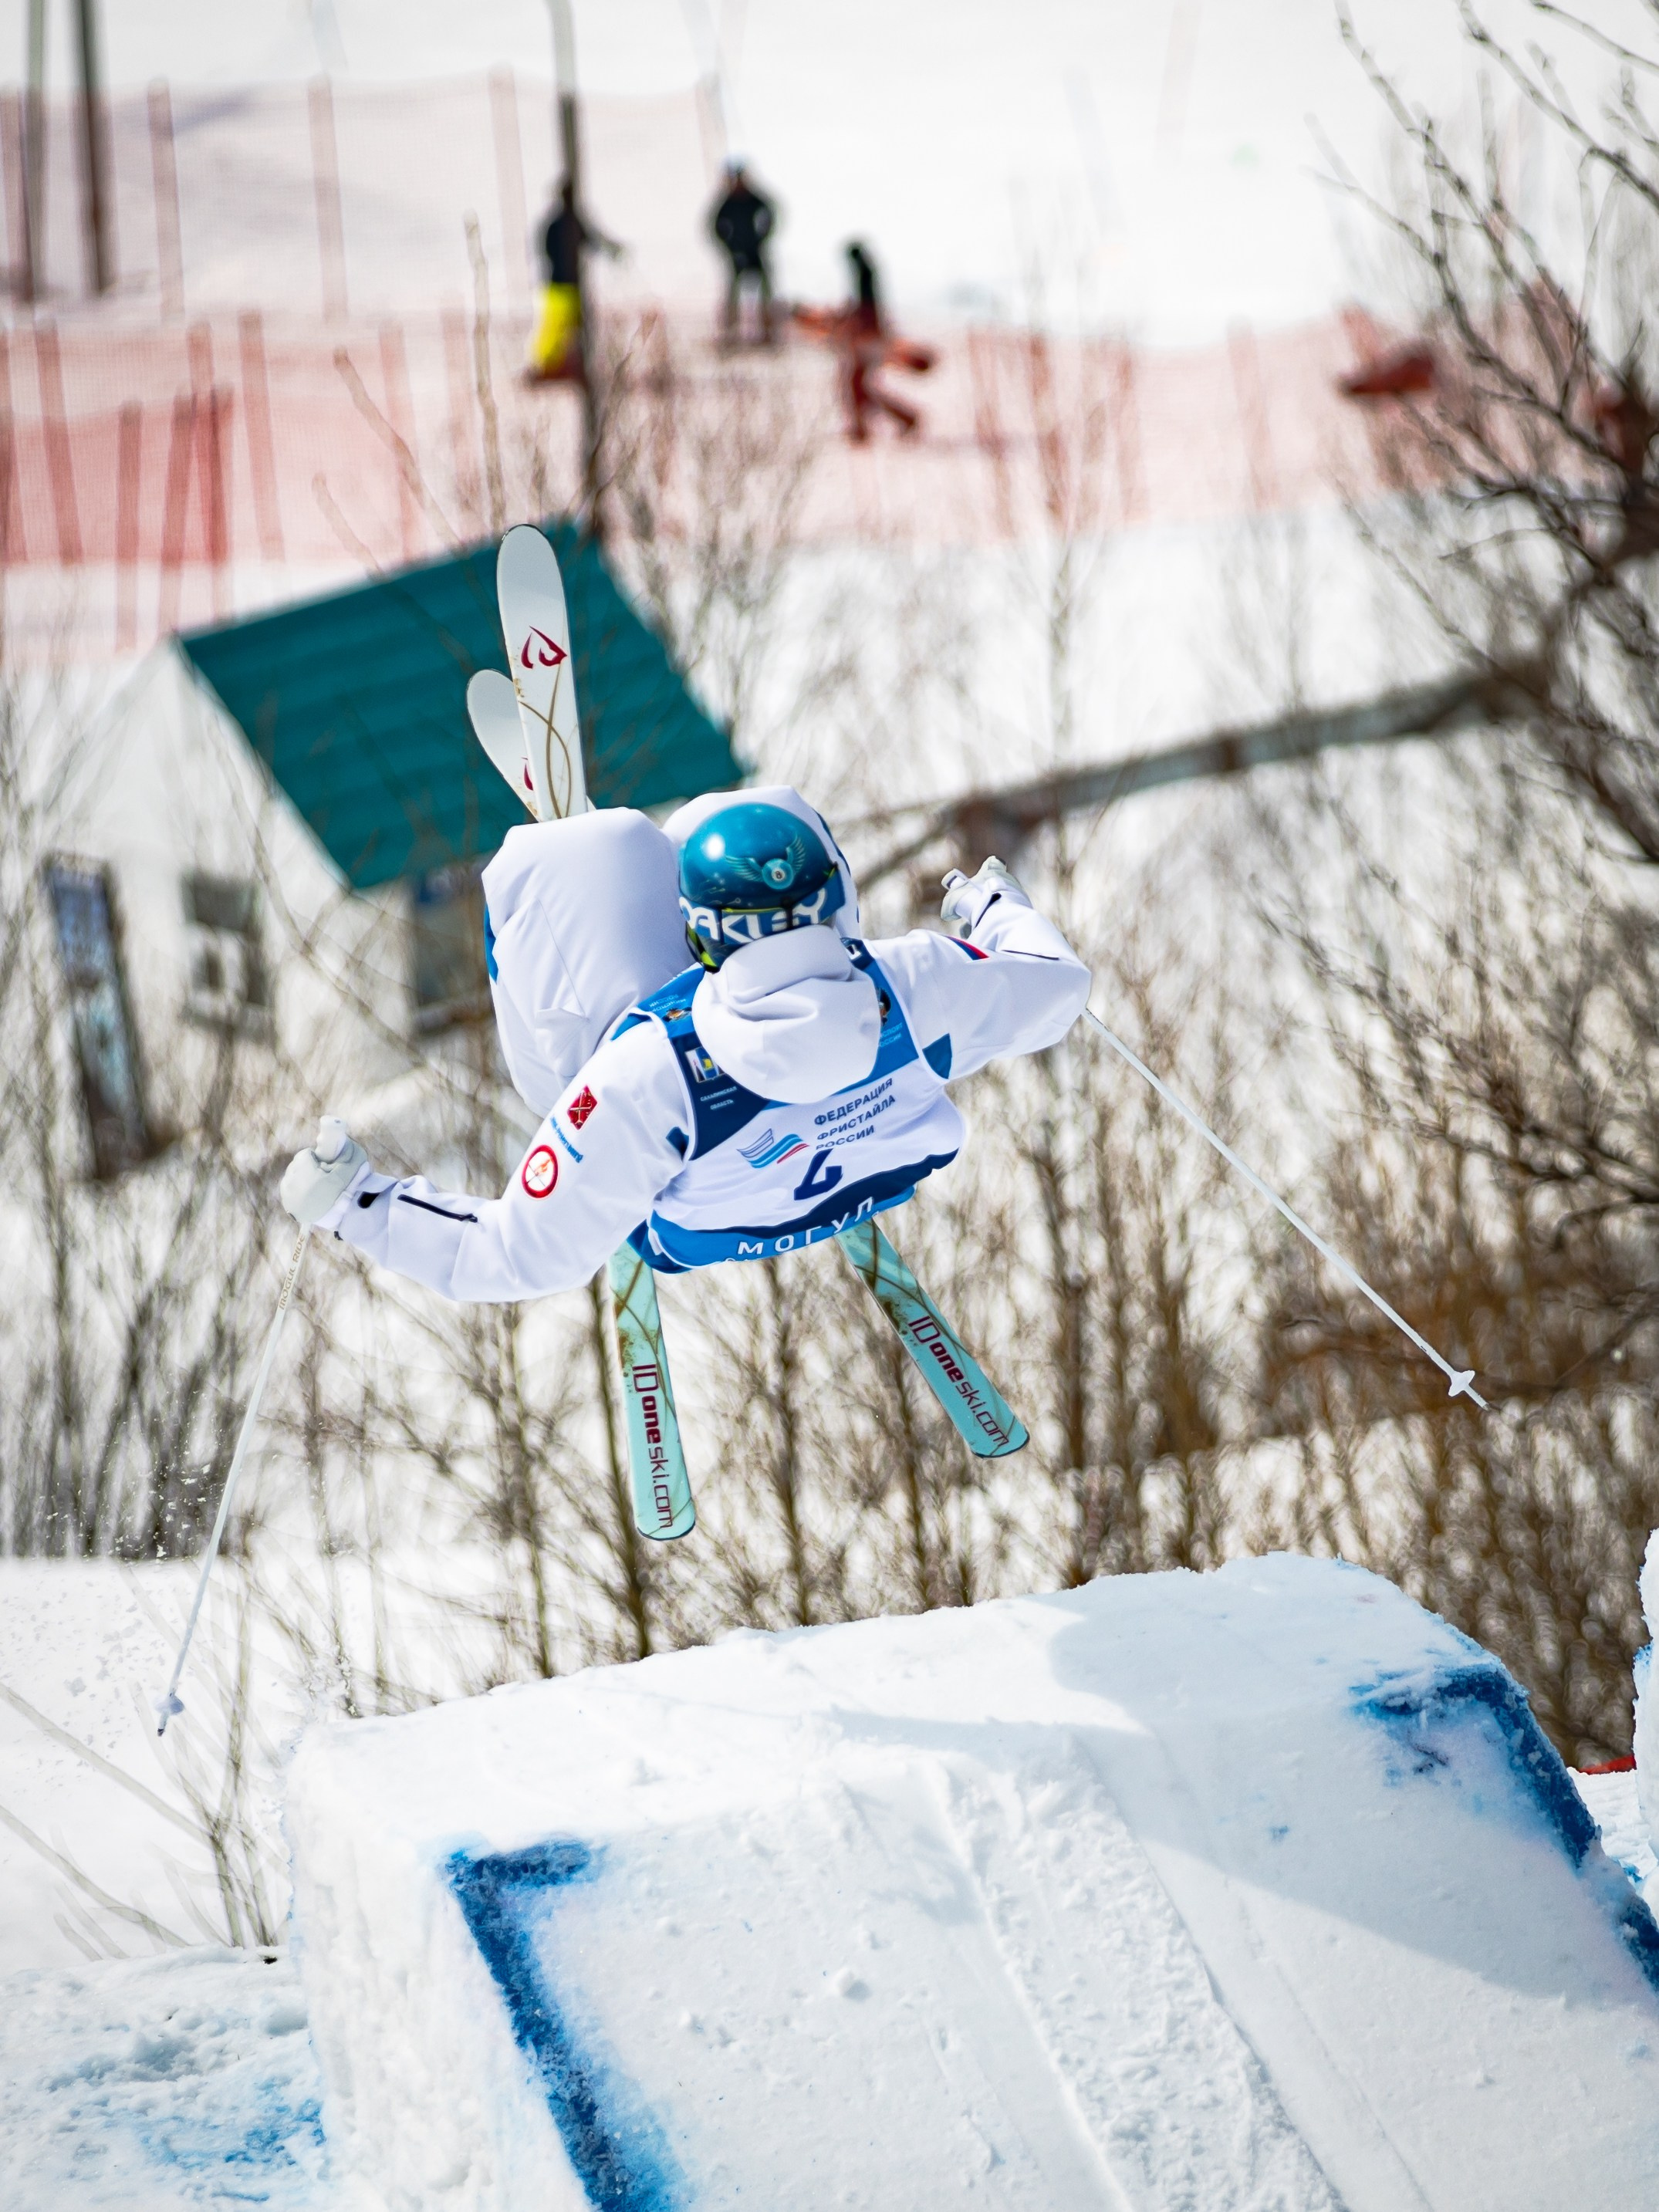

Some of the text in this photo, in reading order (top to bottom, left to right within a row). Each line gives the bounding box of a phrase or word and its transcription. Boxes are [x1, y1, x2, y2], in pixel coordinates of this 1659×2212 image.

[678, 887, 827, 944] OAKLEY
[814, 1078, 893, 1126] ФЕДЕРАЦИЯ
[817, 1095, 896, 1140] ФРИСТАЙЛА
[816, 1125, 874, 1150] РОССИИ
[738, 1197, 874, 1255] МОГУЛ
